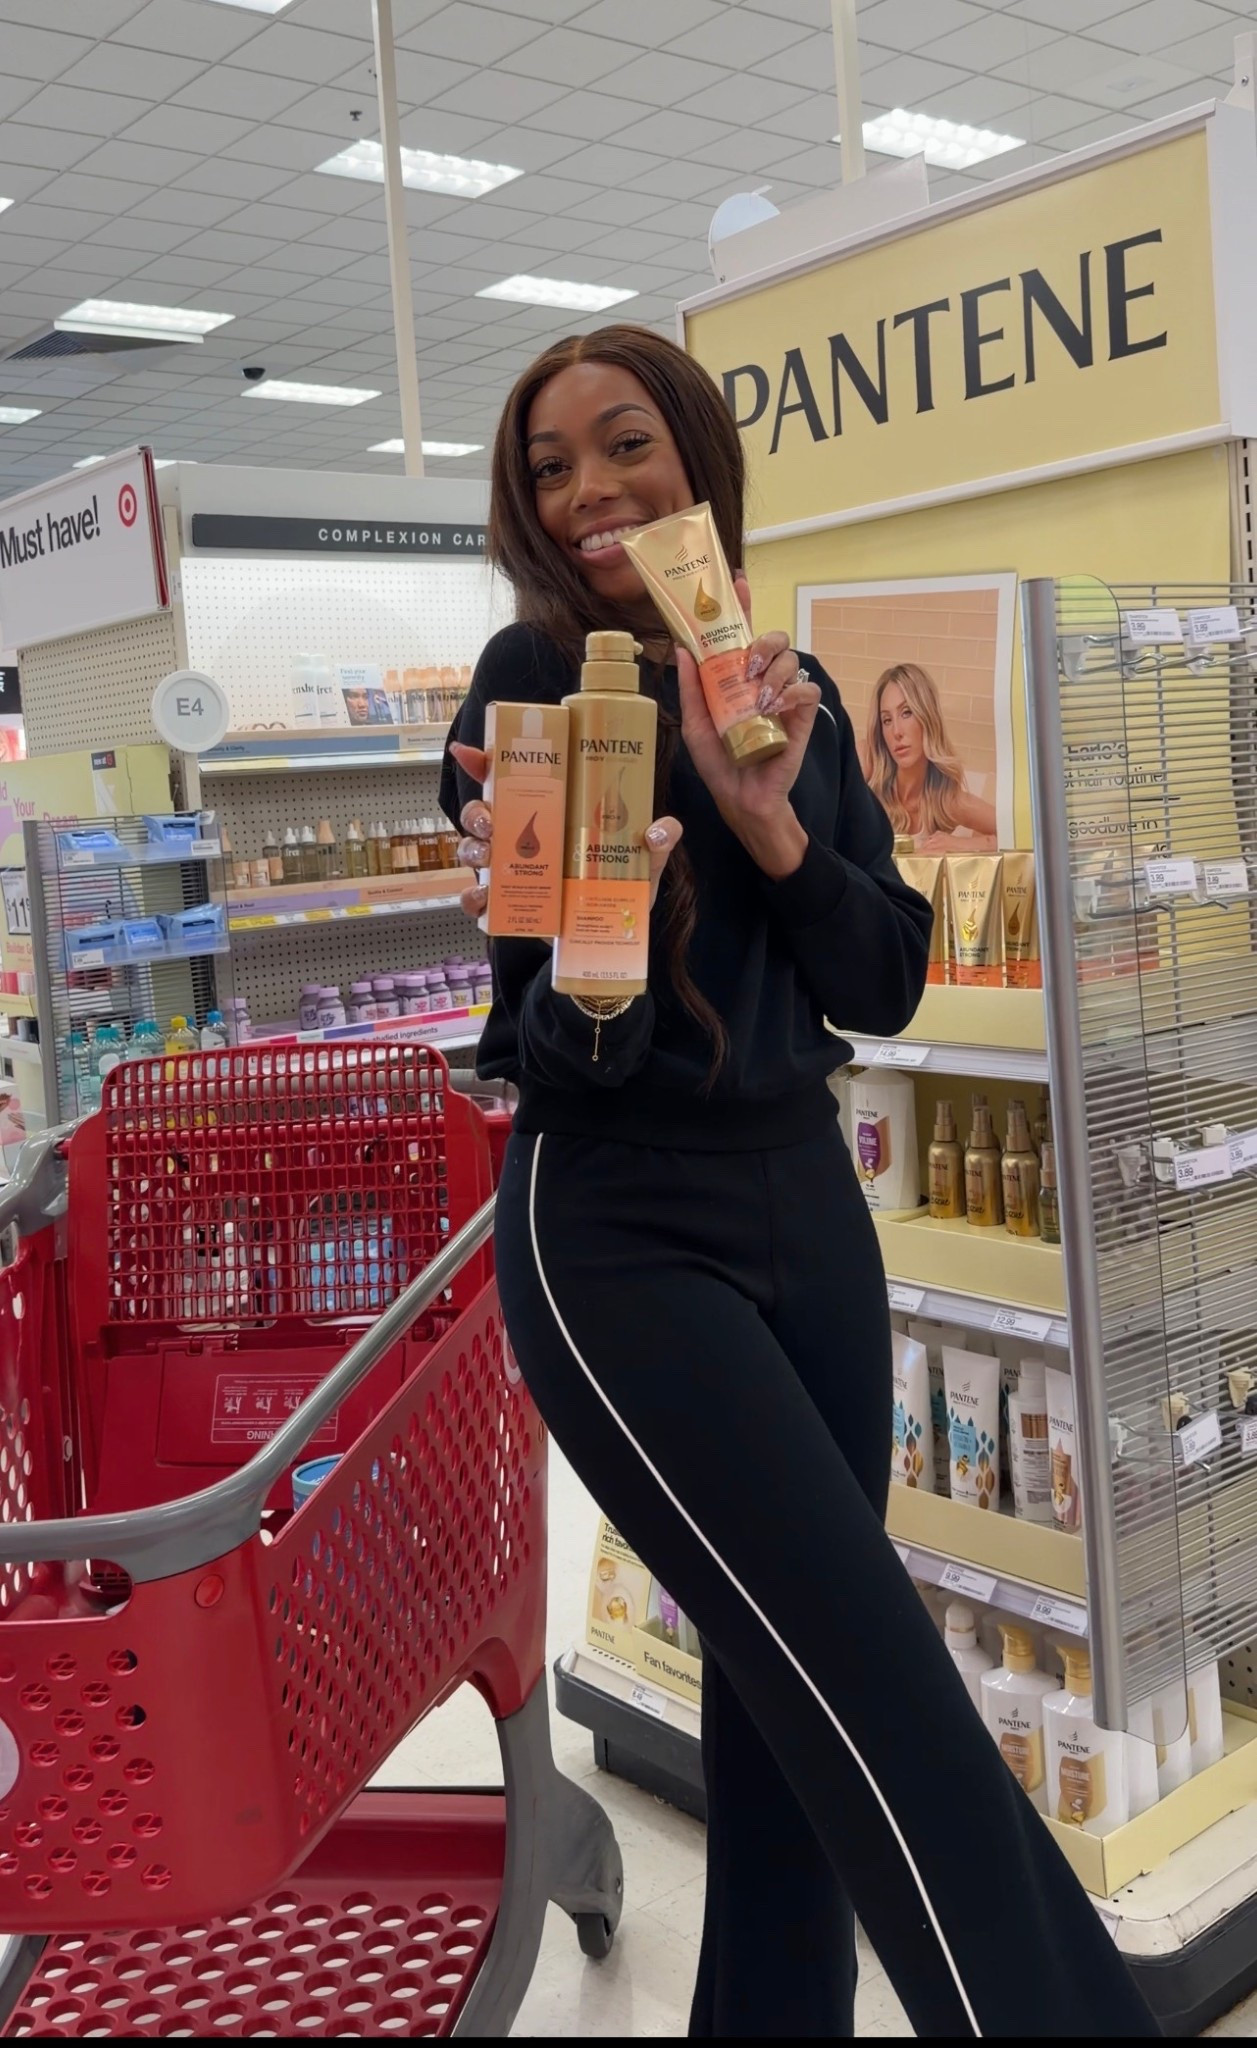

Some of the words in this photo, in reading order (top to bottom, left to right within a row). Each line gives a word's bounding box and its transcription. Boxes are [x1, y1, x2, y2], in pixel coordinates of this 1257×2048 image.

[721, 228, 1168, 455] PANTENE
[0, 518, 45, 569] Must
[46, 494, 100, 553] have!
[318, 527, 442, 546] COMPLEXION
[453, 532, 486, 546] CAR
[664, 553, 711, 578] PANTENE
[700, 623, 744, 641] ABUNDANT
[702, 631, 737, 648] STRONG
[176, 697, 205, 717] E4
[580, 738, 644, 755] PANTENE
[501, 750, 562, 765] PANTENE
[13, 797, 36, 818] Your
[586, 843, 642, 854] ABUNDANT
[585, 853, 630, 864] STRONG
[508, 863, 549, 871] ABUNDANT
[514, 869, 543, 877] STRONG
[399, 1026, 438, 1039] ingredients
[1178, 1166, 1194, 1179] 3.89
[950, 1390, 980, 1406] PANTENE
[1049, 1415, 1074, 1433] PANTENE
[945, 1571, 960, 1583] 9.99
[1035, 1604, 1051, 1616] 9.99
[591, 1626, 616, 1644] PANTENE
[644, 1650, 661, 1669] Fan
[998, 1717, 1031, 1729] PANTENE
[1057, 1739, 1091, 1754] PANTENE
